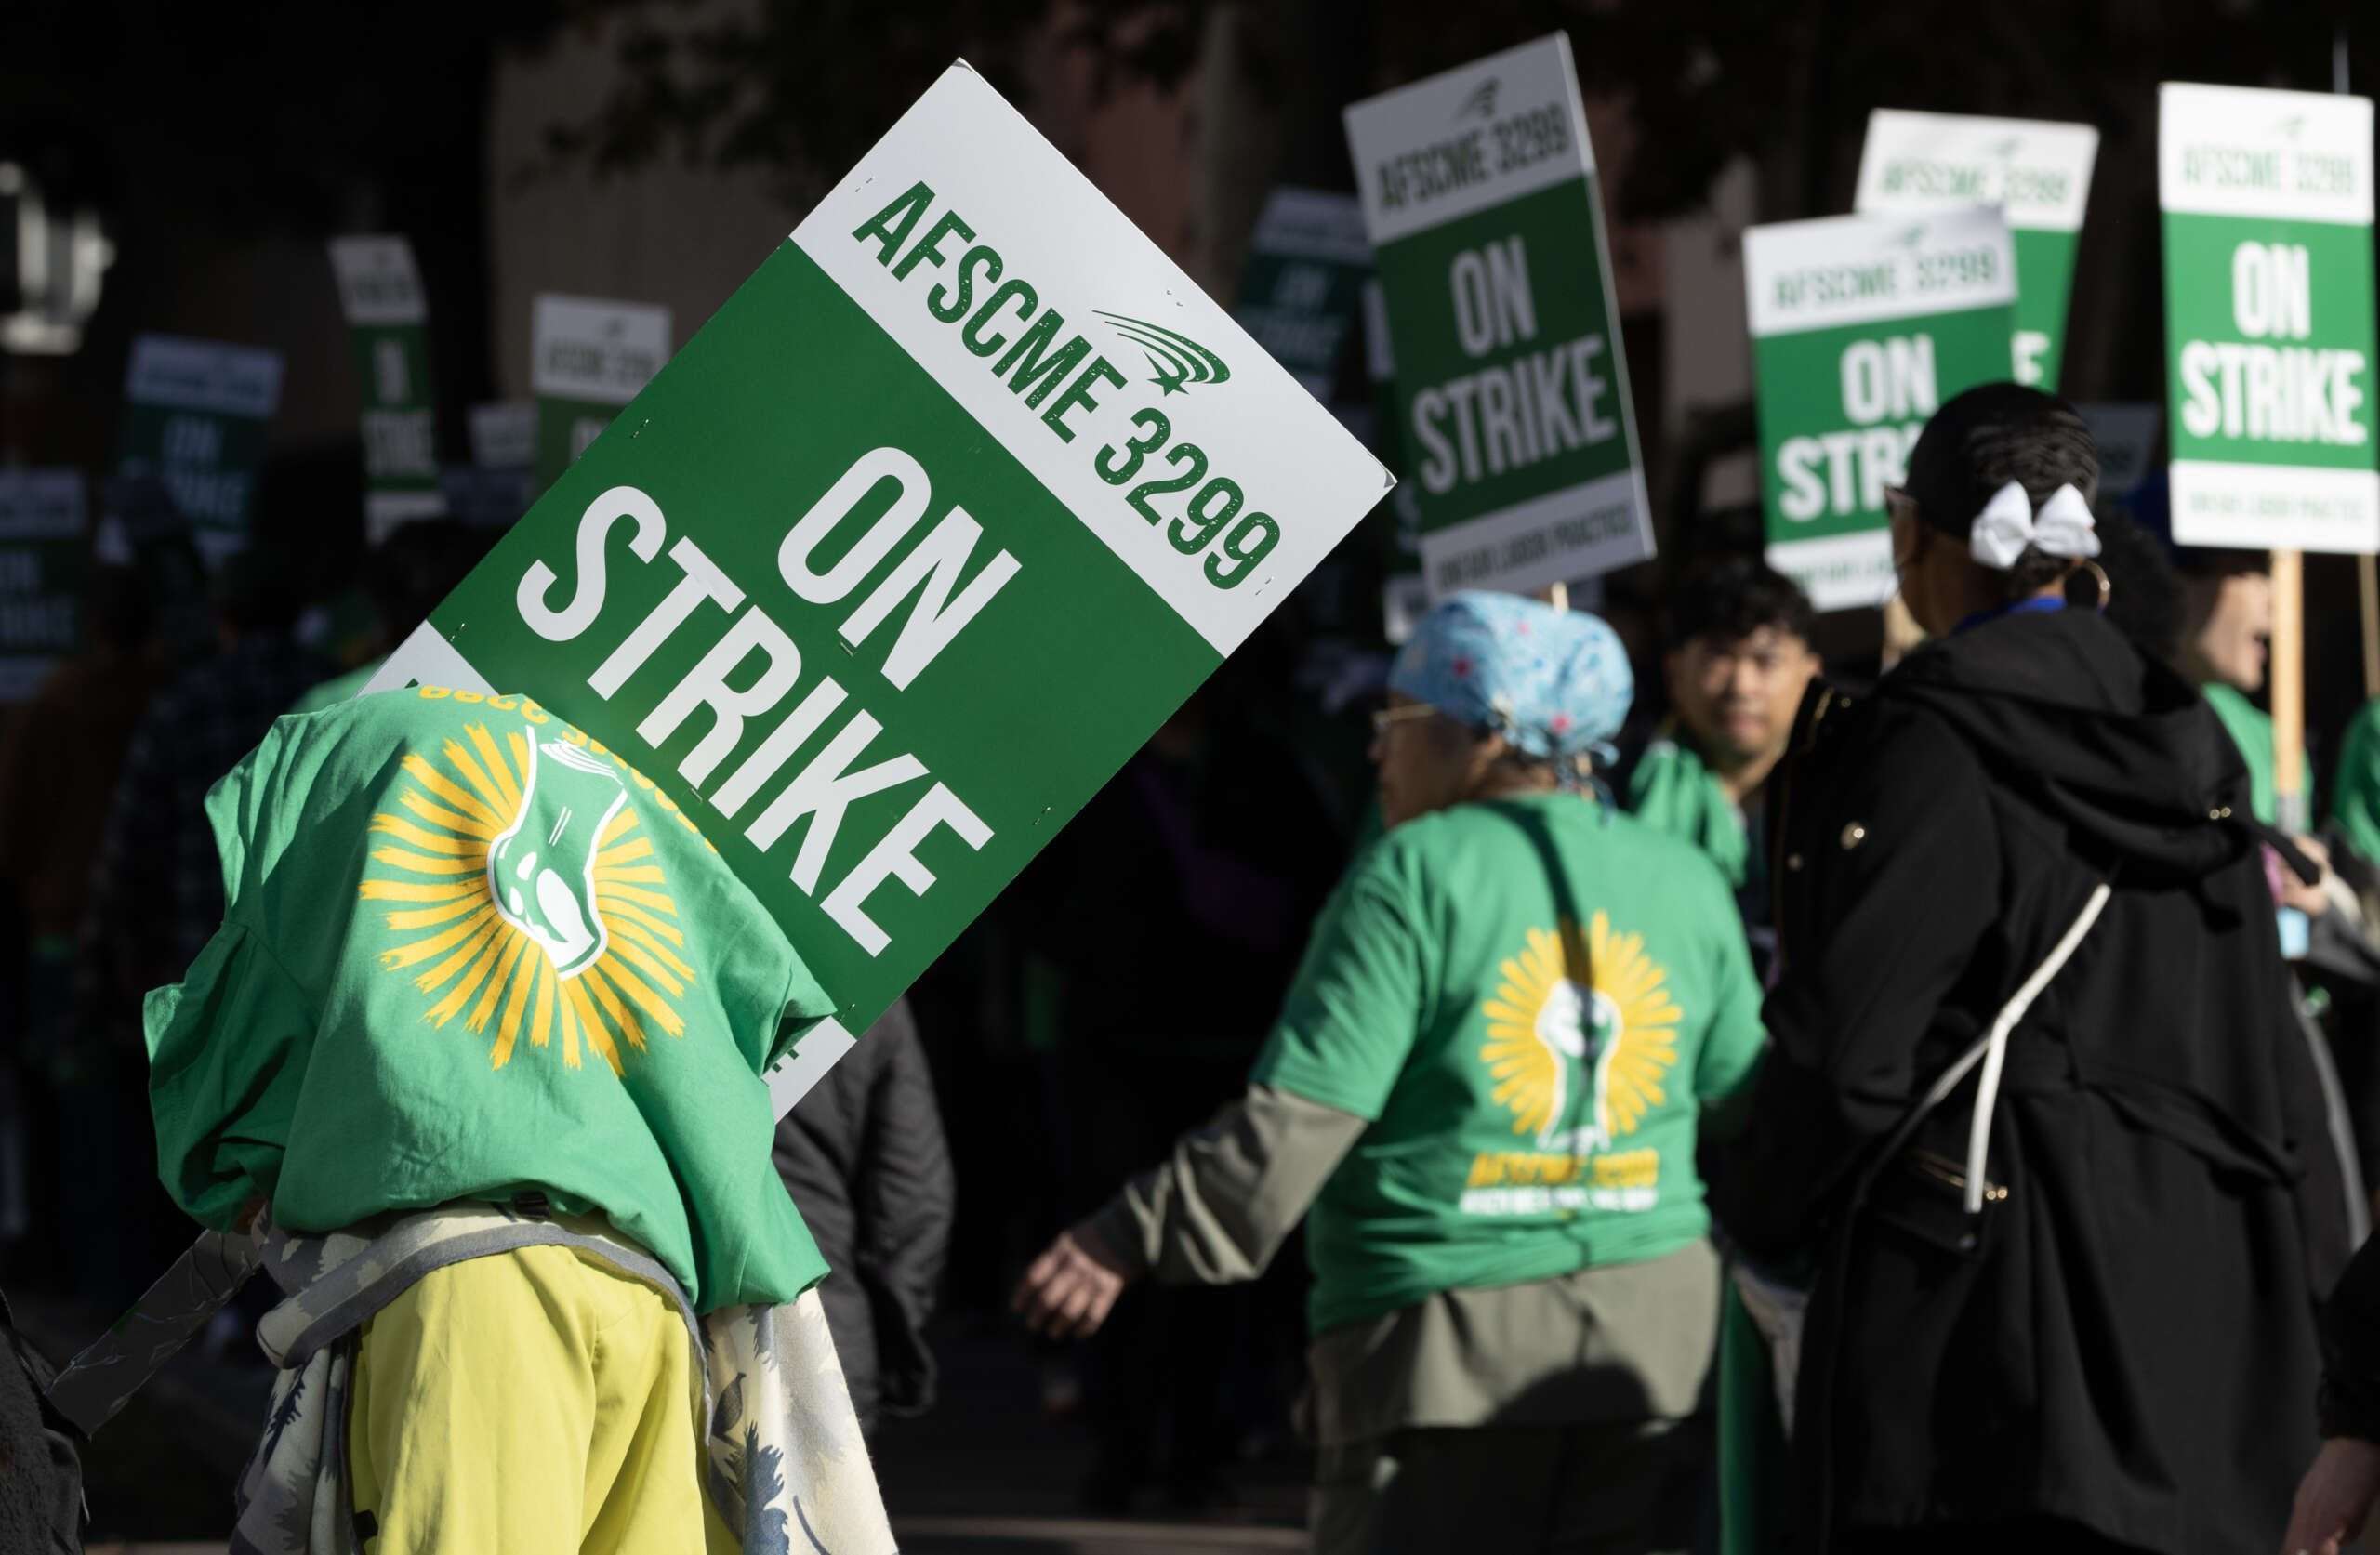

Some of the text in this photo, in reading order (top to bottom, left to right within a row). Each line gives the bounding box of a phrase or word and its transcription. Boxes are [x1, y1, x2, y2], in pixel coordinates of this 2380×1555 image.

[1379, 103, 1568, 208] AFSCME 3299
[1449, 234, 1536, 357] ON
[2232, 240, 2310, 338] ON
[852, 181, 1280, 589] AFSCME 3299
[1411, 333, 1618, 494] STRIKE
[1840, 332, 1938, 425] ON
[2180, 339, 2367, 445] STRIKE
[1777, 421, 1924, 522] STR
[778, 447, 1022, 691] ON
[517, 486, 994, 957] STRIKE
